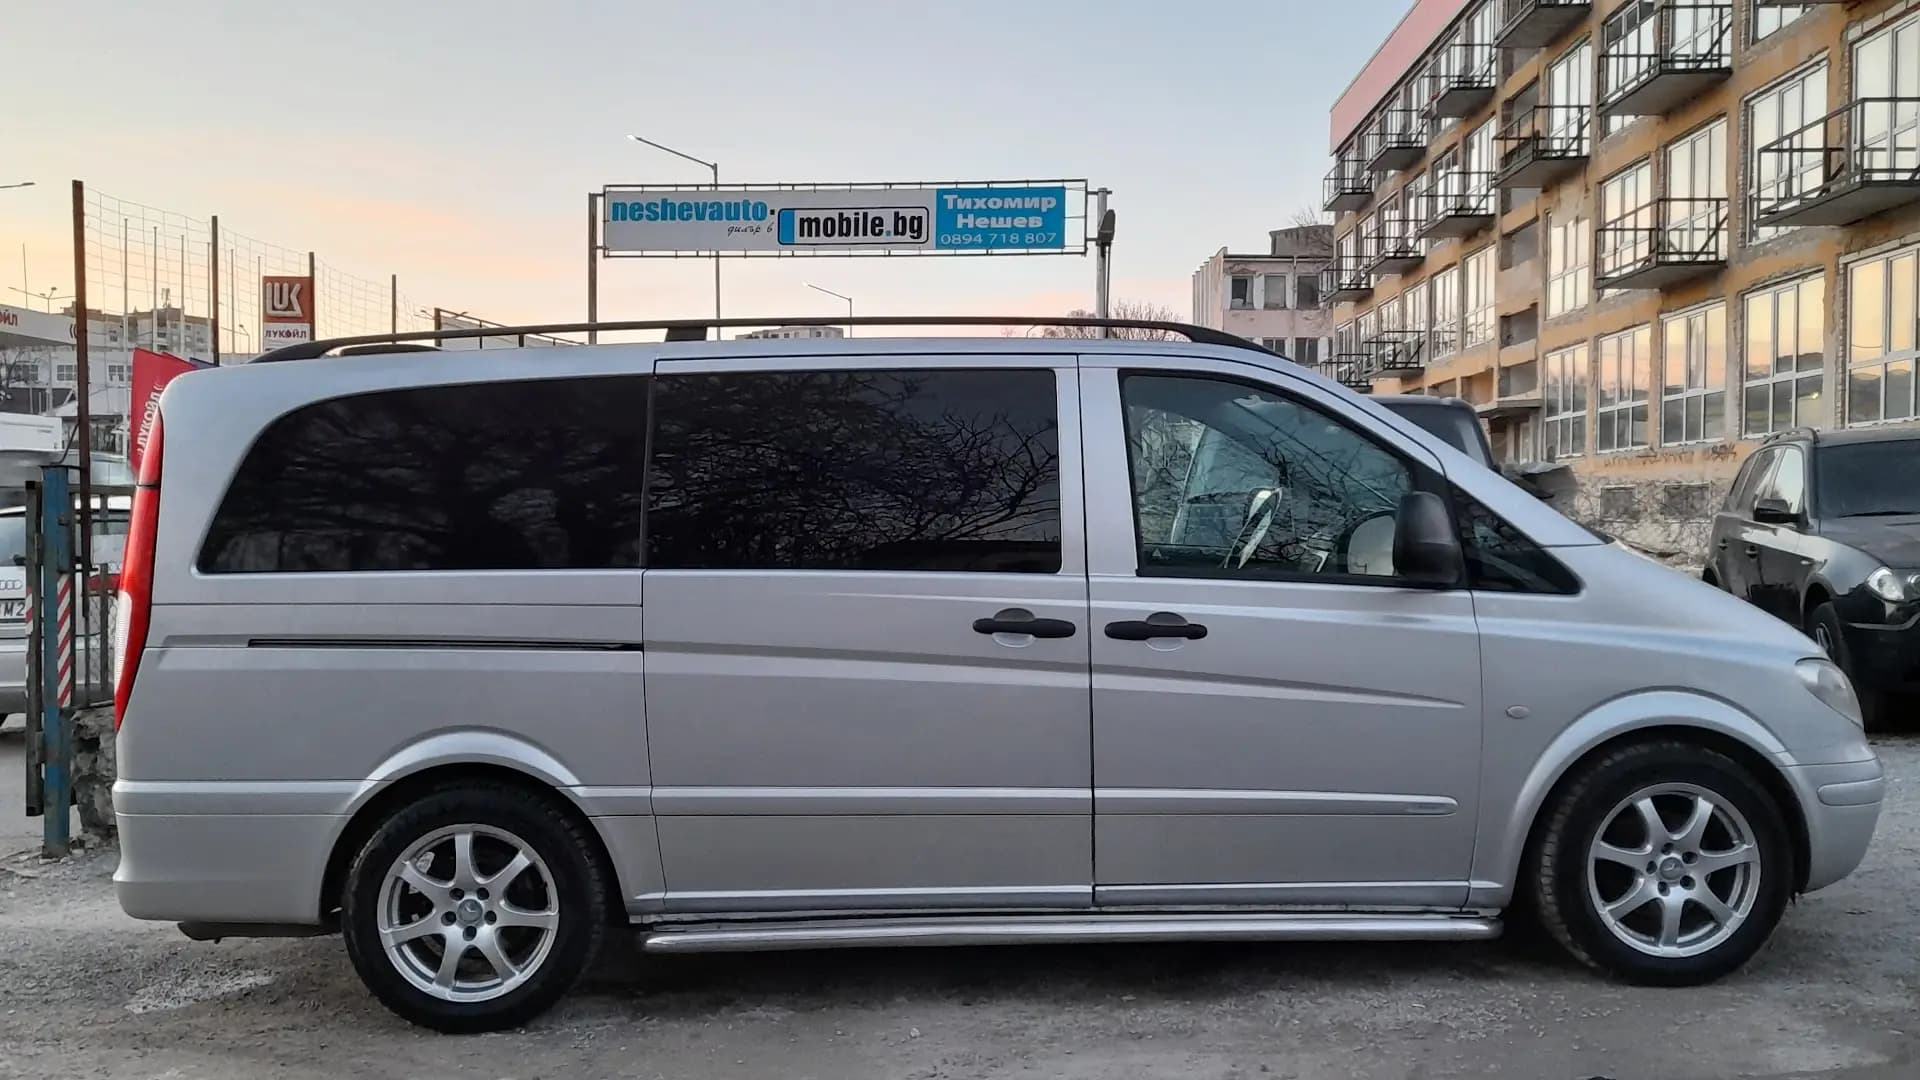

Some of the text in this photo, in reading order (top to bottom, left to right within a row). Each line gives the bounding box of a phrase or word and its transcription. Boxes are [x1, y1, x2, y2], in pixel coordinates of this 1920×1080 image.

[943, 194, 1057, 212] Тихомир
[799, 211, 923, 240] mobile.bg
[956, 213, 1043, 229] Нешев
[940, 232, 1057, 245] 0894 718 807
[265, 328, 307, 339] ЛУКОЙЛ
